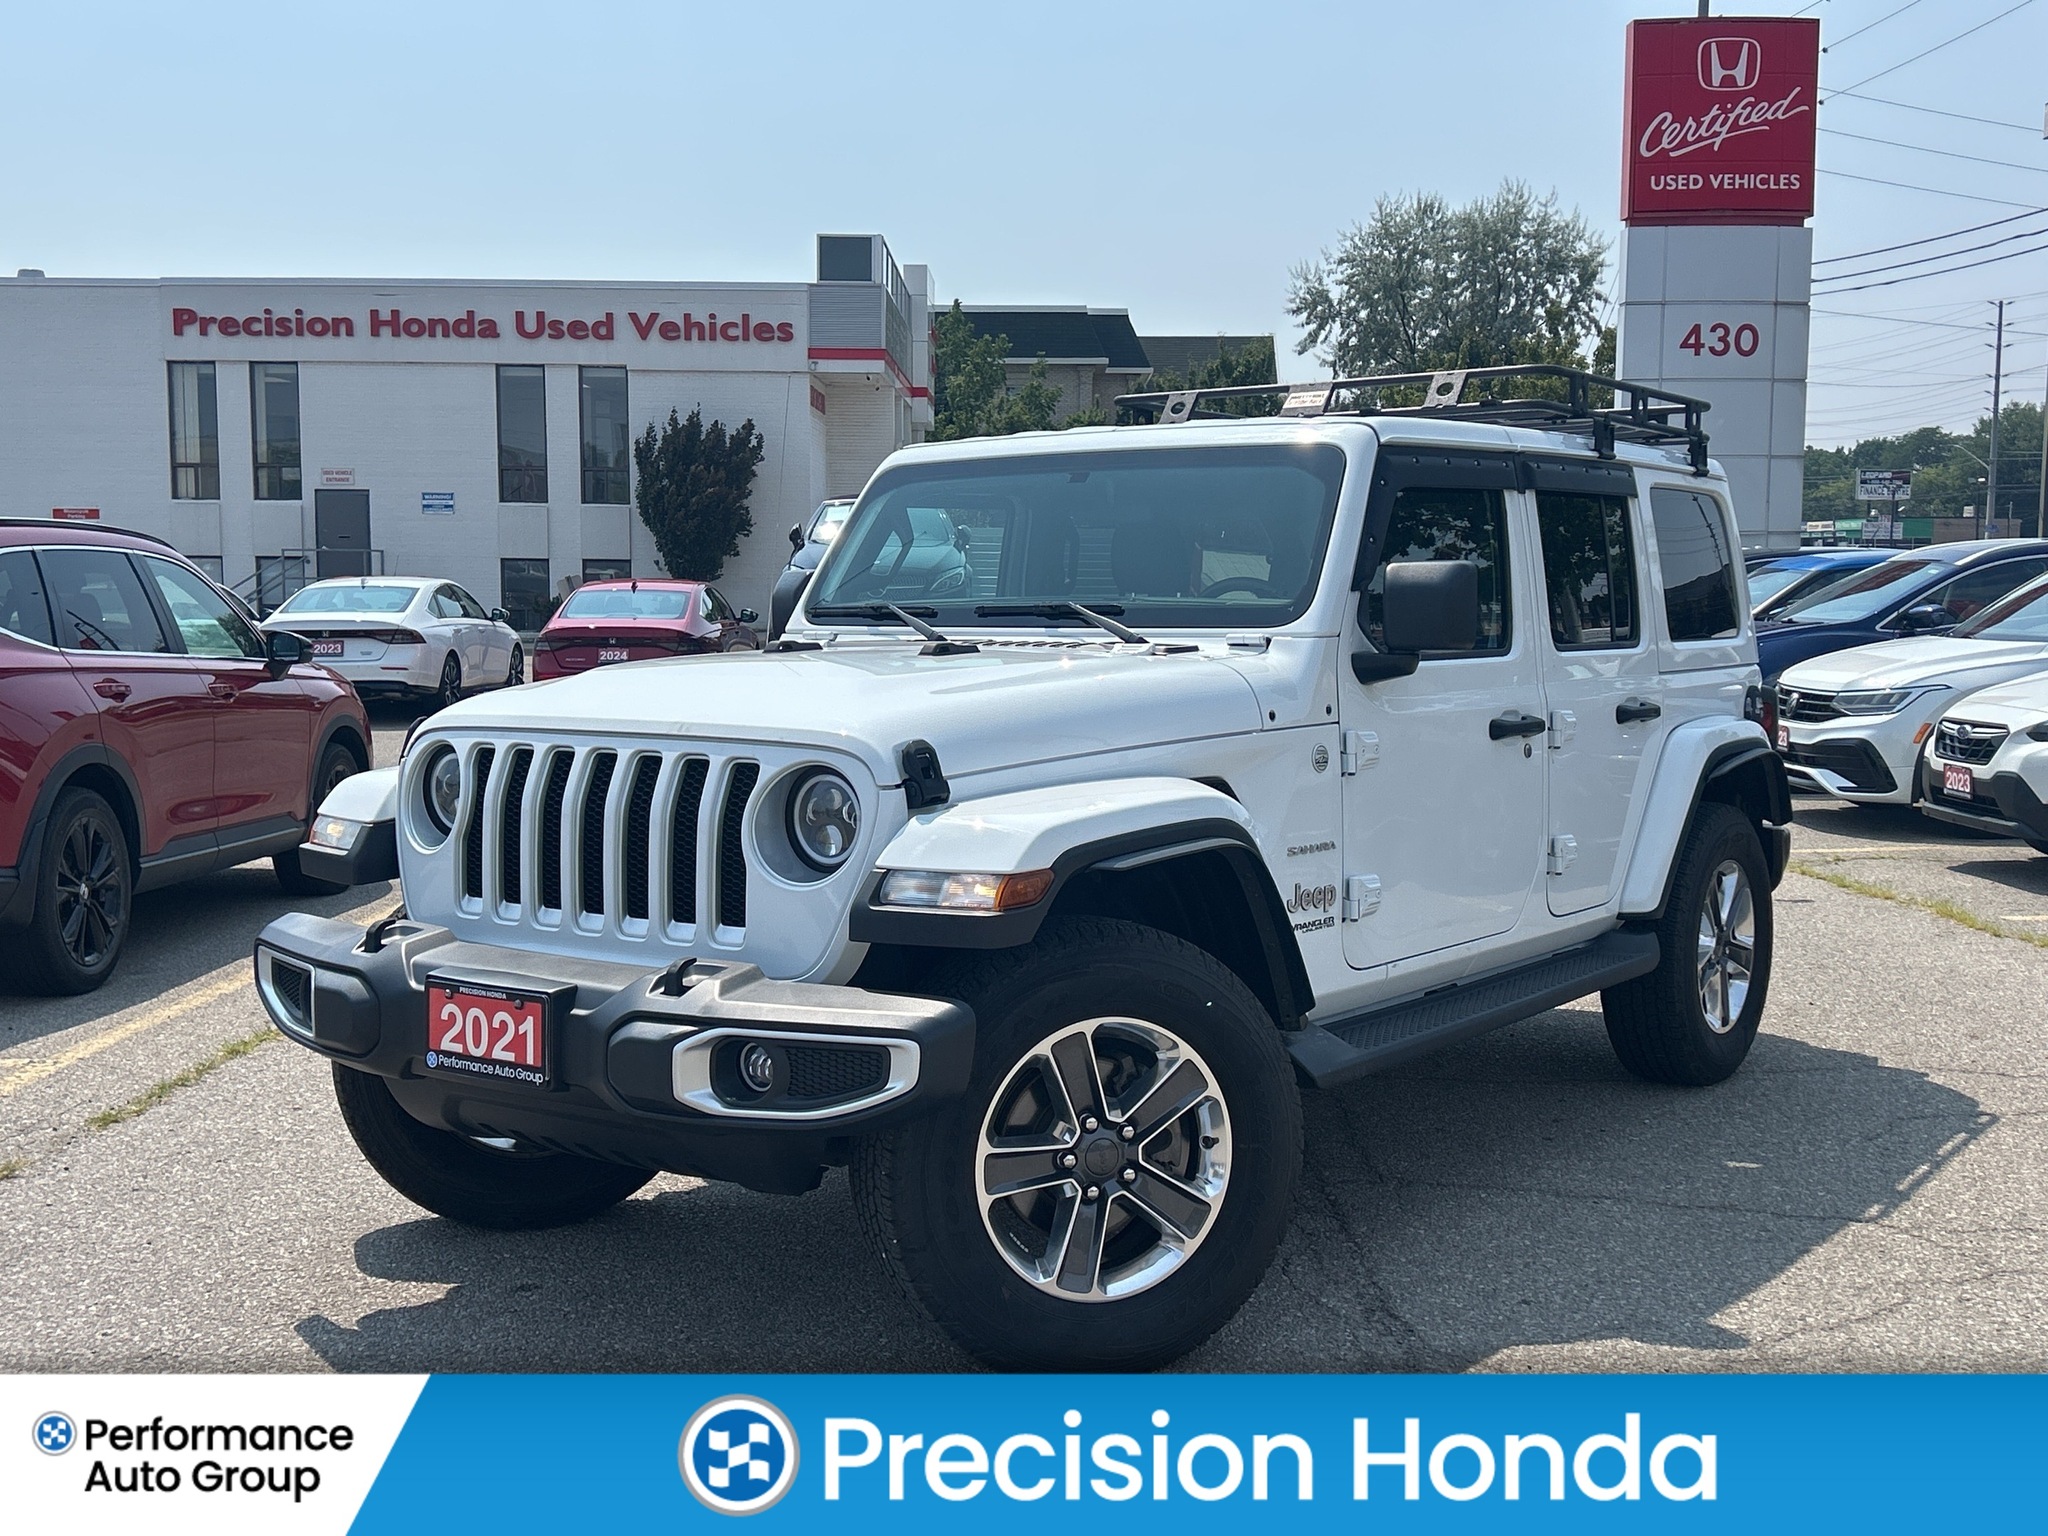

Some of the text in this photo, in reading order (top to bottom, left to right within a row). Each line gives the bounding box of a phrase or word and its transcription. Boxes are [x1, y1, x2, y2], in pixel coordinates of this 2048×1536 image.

[1639, 86, 1810, 158] Certified
[1651, 173, 1801, 191] USED VEHICLES
[172, 307, 795, 342] Precision Honda Used Vehicles
[1679, 322, 1760, 357] 430
[1860, 485, 1886, 496] FINANCE
[313, 643, 342, 654] 2023
[599, 651, 629, 661] 2024
[1778, 730, 1788, 746] 23
[1946, 771, 1970, 792] 2023
[1286, 841, 1336, 857] SAHARA
[1286, 883, 1337, 914] Jeep
[459, 986, 507, 1000] PRECISION HONDA
[440, 1003, 534, 1066] 2021
[438, 1054, 544, 1086] Performance Auto Group
